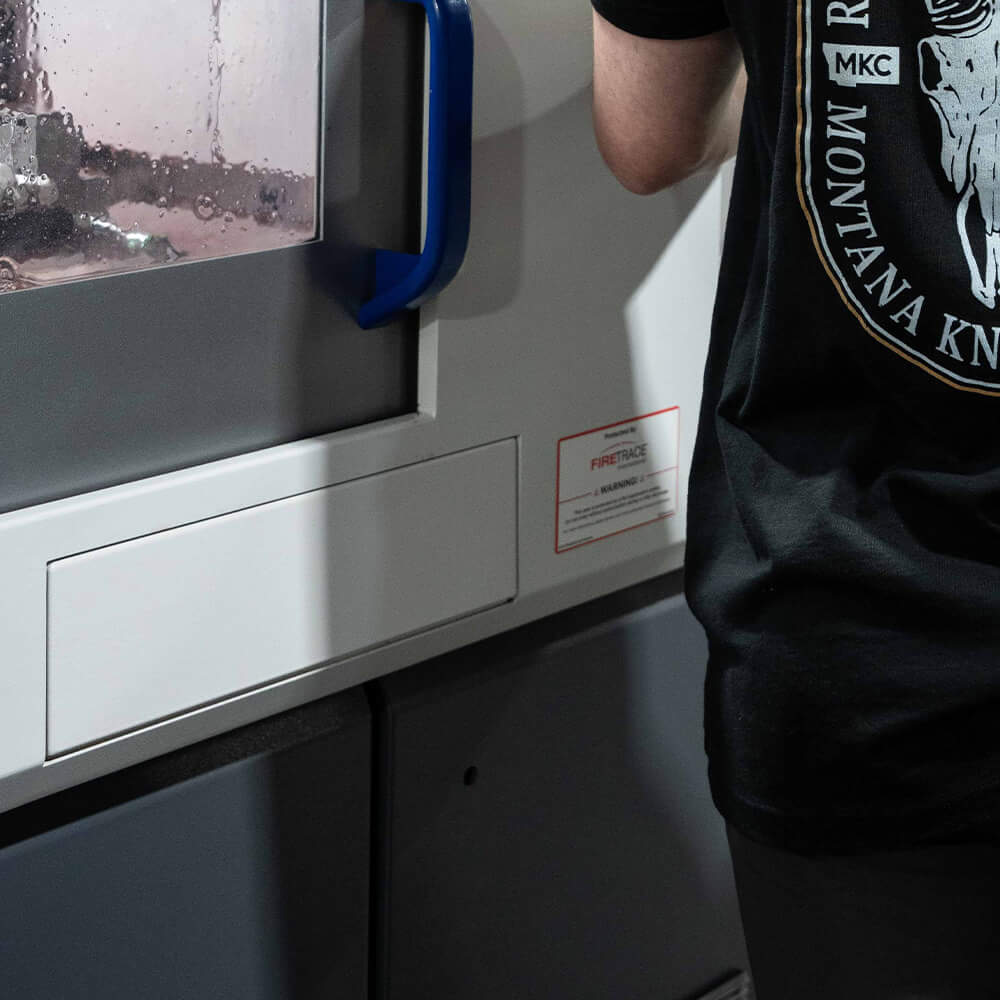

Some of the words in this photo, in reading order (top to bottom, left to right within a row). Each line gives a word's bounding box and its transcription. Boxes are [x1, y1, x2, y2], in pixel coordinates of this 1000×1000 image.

[835, 51, 892, 77] MKC
[826, 101, 927, 337] MONTANA
[590, 442, 648, 472] FIRETRACE
